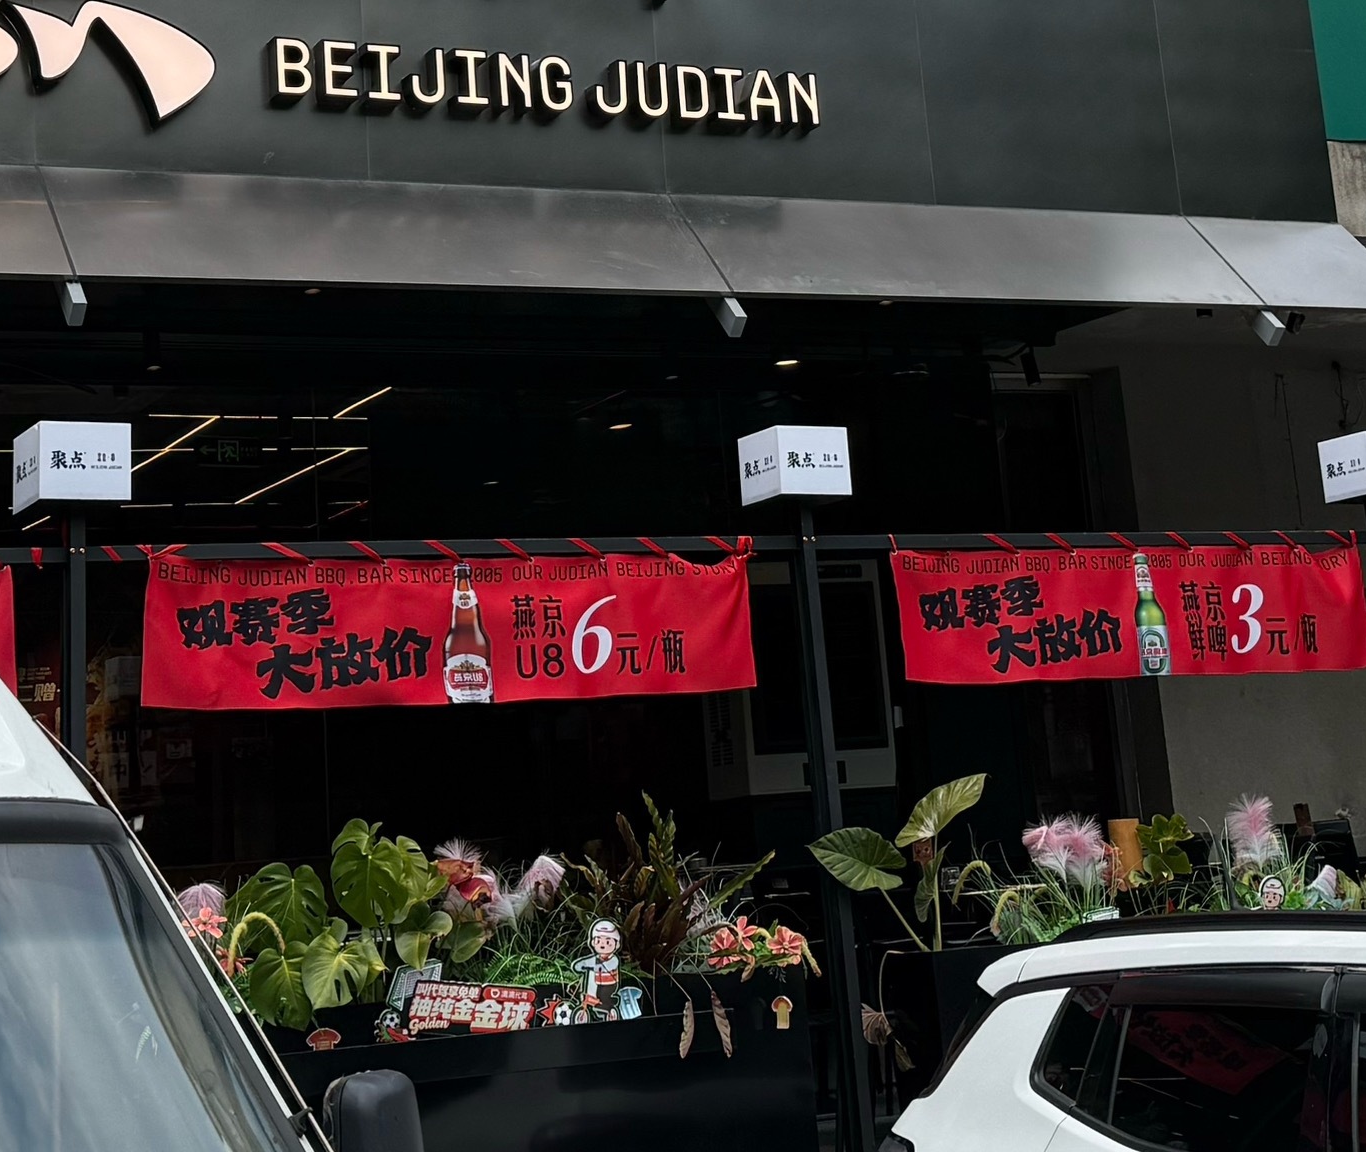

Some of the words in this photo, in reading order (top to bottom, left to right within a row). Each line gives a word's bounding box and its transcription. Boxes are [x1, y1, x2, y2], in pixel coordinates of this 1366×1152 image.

[271, 35, 575, 116] BEIJING
[590, 58, 821, 129] JUDIAN
[50, 450, 86, 469] 聚点
[787, 451, 815, 468] 聚点
[158, 562, 231, 585] BEIJING
[237, 567, 307, 586] JUDIAN
[398, 567, 454, 584] SINCE
[473, 567, 503, 583] 005
[512, 566, 543, 581] OUR
[549, 561, 608, 581] JUDIAN
[616, 560, 685, 577] BEIJING
[902, 555, 960, 573] BEIJING
[966, 556, 1019, 574] JUDIAN
[1090, 554, 1132, 570] SINCE
[1179, 552, 1205, 568] OUR
[1211, 551, 1253, 568] JUDIAN
[176, 587, 335, 650] 观赛季
[510, 594, 566, 640] 燕京
[919, 575, 1044, 631] 观赛季
[515, 643, 565, 679] U8
[987, 609, 1122, 674] 大放价
[256, 626, 432, 700] 大放价
[409, 1017, 451, 1035] Golden
